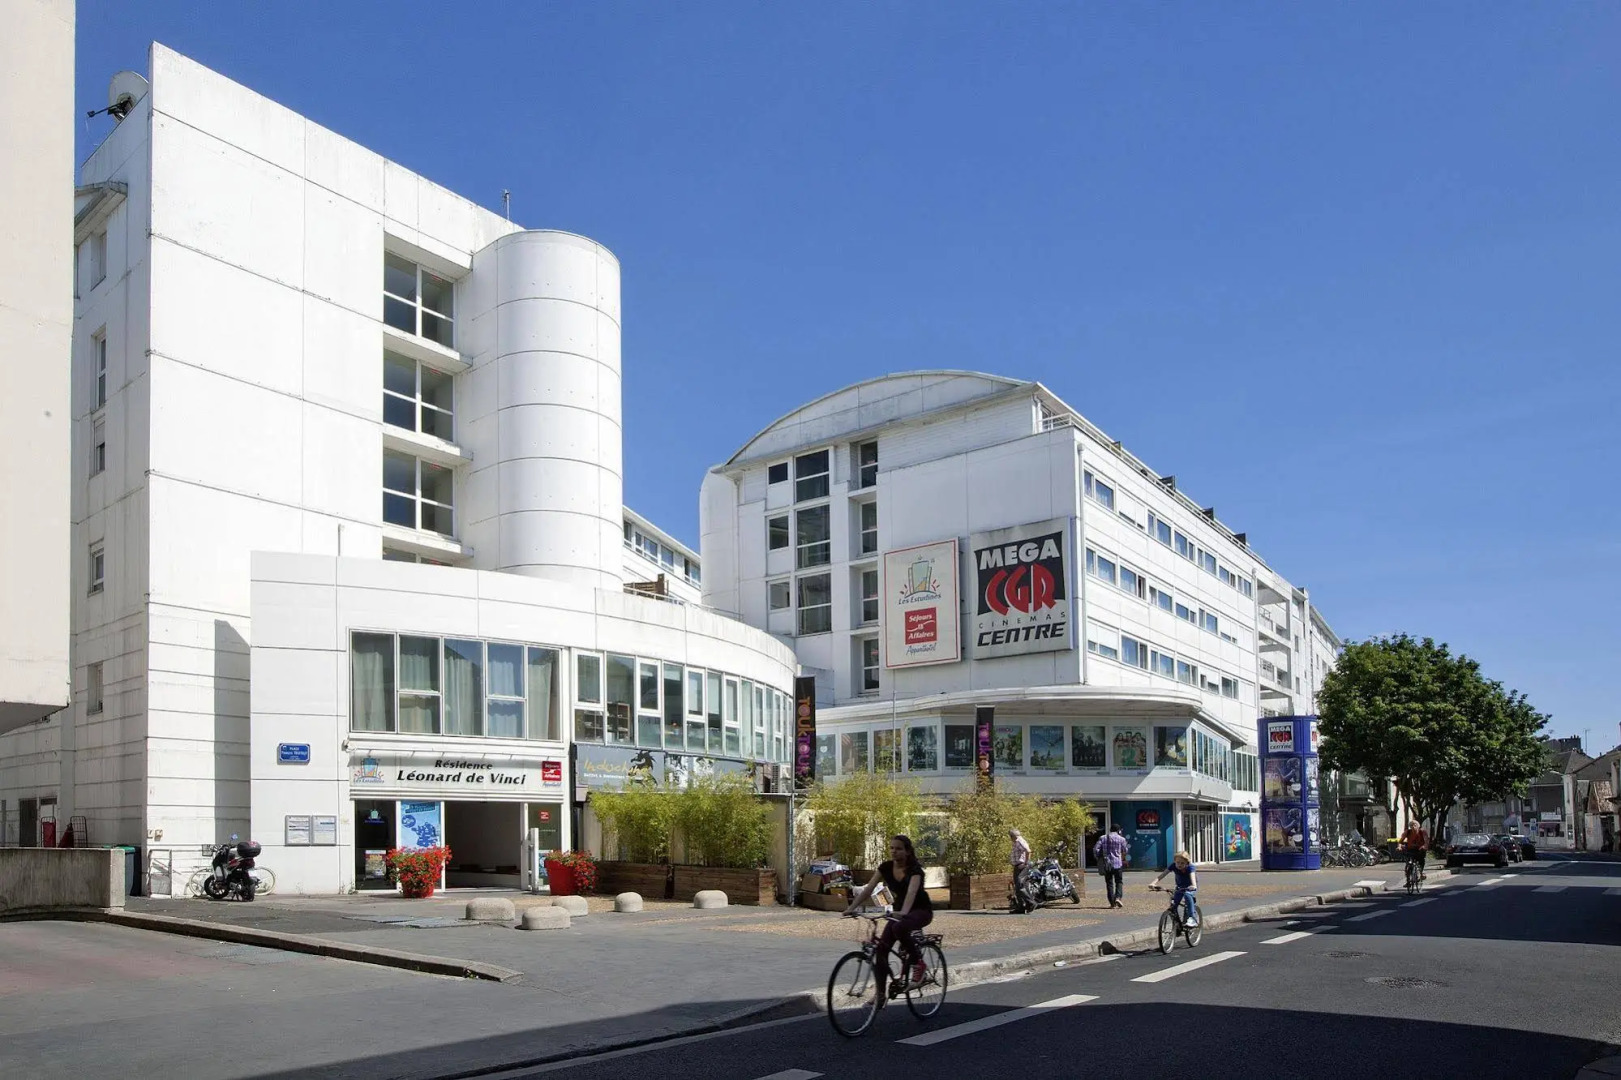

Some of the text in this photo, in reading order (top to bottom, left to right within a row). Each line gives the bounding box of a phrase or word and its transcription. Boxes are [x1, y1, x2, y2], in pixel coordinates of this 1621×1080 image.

[980, 539, 1060, 570] MEGA
[985, 563, 1056, 616] CGR
[898, 596, 909, 605] Les
[979, 612, 1066, 629] CINEMAS
[908, 631, 934, 640] Affaires
[977, 622, 1066, 647] CENTRE
[434, 759, 493, 770] Résidence
[397, 770, 526, 785] Léonard de Vinci
